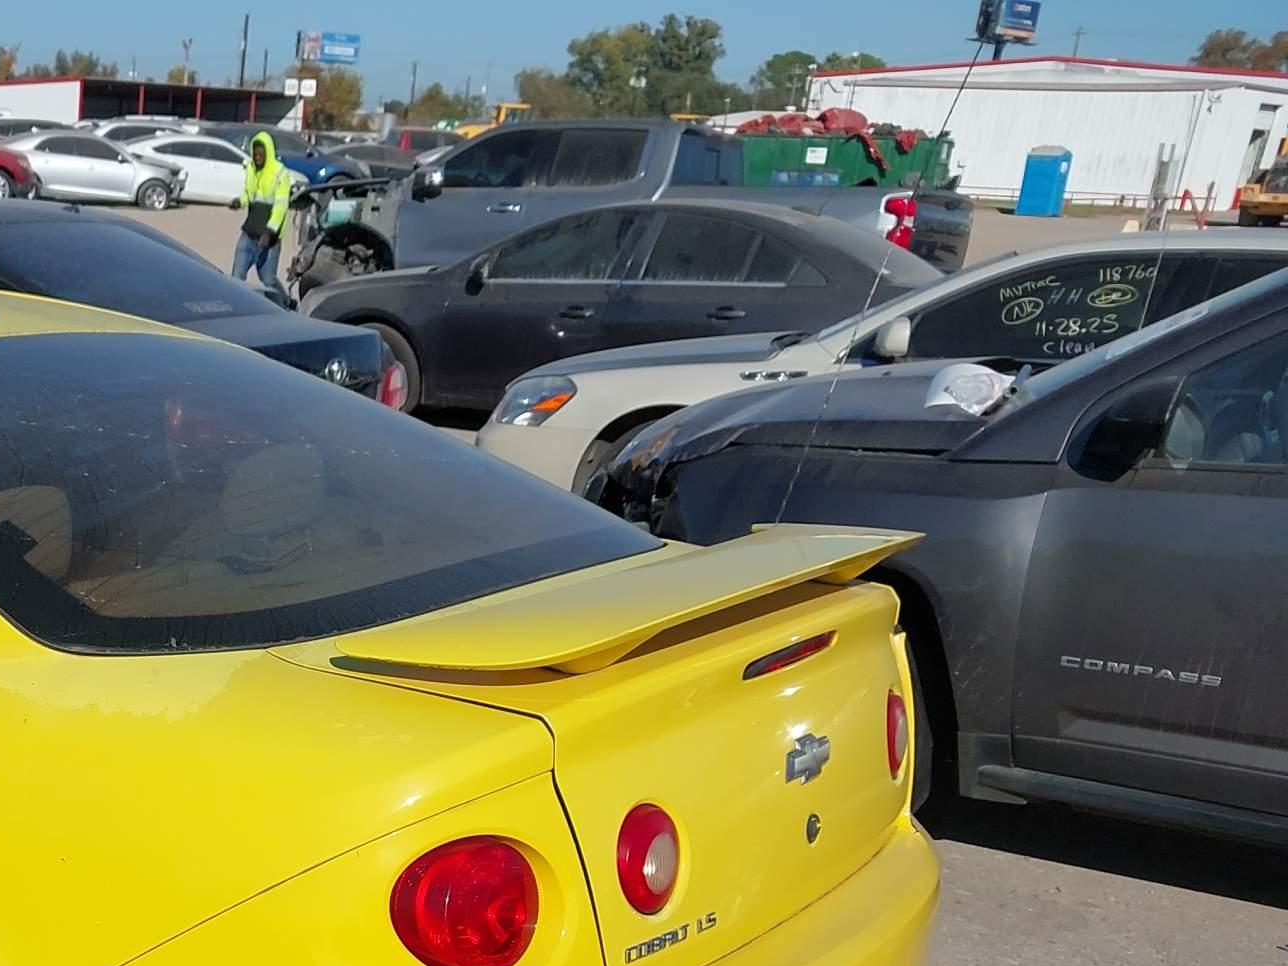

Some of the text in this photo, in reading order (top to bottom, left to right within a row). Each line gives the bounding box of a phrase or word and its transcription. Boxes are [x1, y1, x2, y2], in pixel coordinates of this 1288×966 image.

[1059, 655, 1223, 687] COMPASS
[624, 911, 718, 964] COBALT LS
